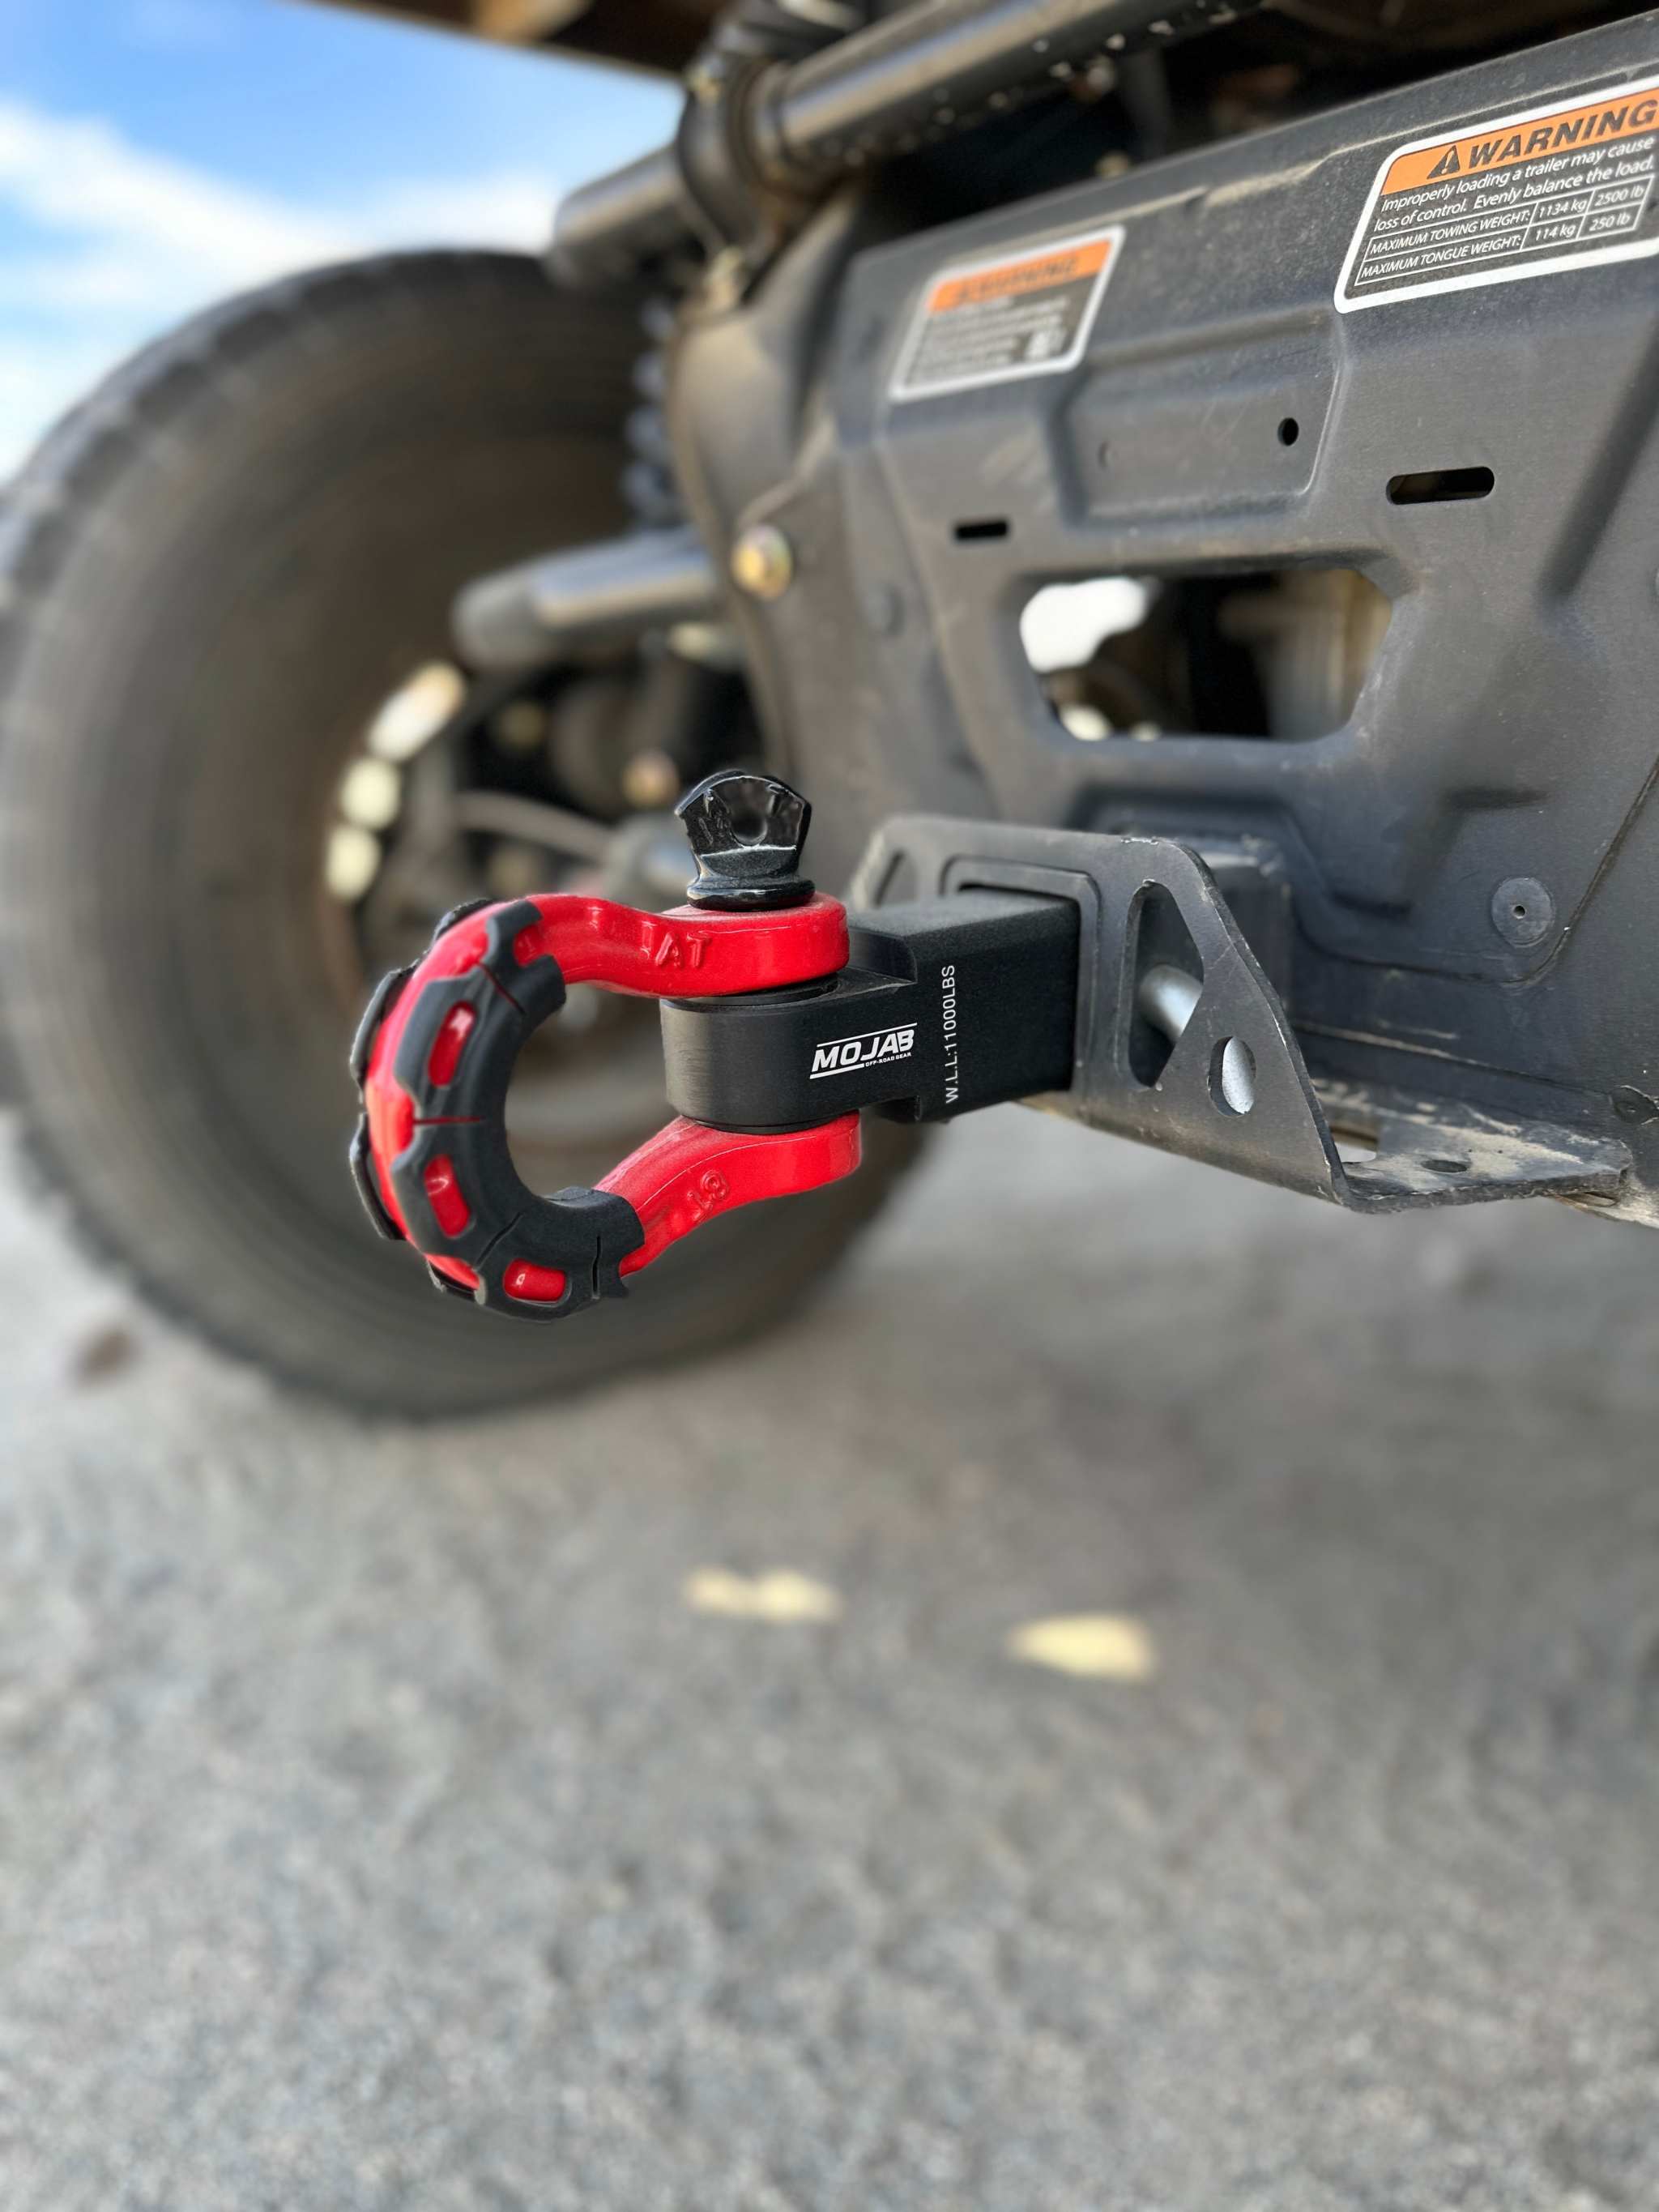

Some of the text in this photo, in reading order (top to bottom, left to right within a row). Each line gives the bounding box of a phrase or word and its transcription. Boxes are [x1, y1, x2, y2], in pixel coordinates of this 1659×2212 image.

[1469, 100, 1658, 169] WARNING
[1374, 153, 1654, 232] loss of control. Evenly balance the load.
[1381, 135, 1656, 212] Improperly loading a trailer may cause
[1361, 213, 1630, 278] MAXIMUM TONGUE WEIGHT: 114 kg 250 lb
[1370, 185, 1644, 254] MAXIMUM TOWING WEIGHT: 1134 kg 2500 lb
[812, 1029, 915, 1072] MOJAB
[865, 1056, 895, 1067] OFF-ROAD
